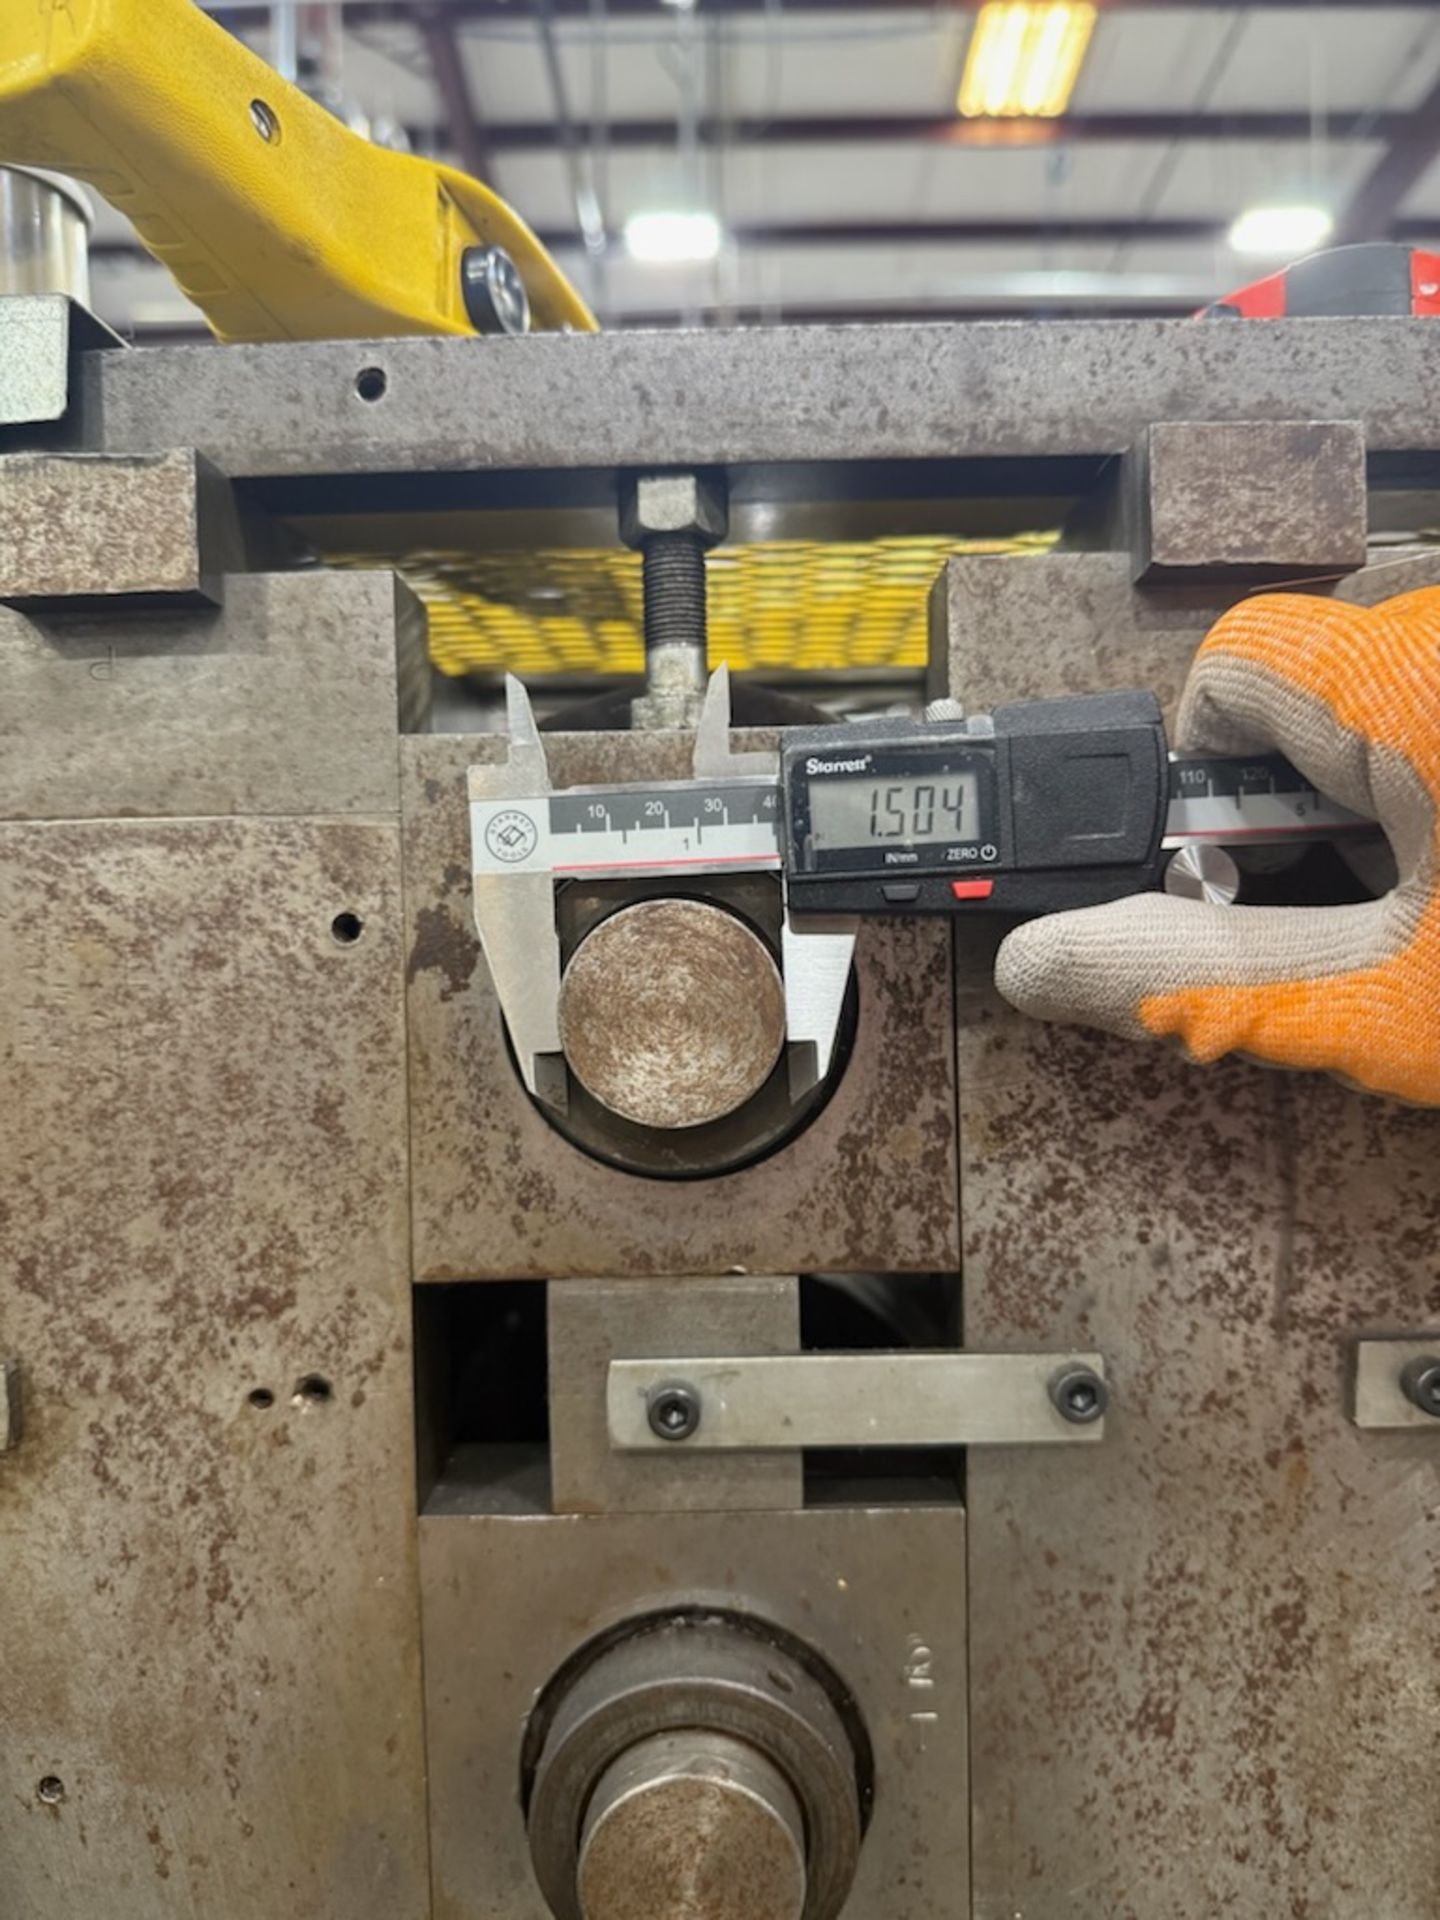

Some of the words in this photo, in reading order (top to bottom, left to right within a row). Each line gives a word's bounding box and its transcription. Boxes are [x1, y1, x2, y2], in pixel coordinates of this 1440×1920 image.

[1179, 768, 1206, 785] 110
[1241, 765, 1269, 781] 120
[587, 804, 606, 819] 10
[644, 800, 664, 816] 20
[704, 797, 723, 813] 30
[869, 784, 964, 838] 1.504
[1294, 801, 1307, 818] 5
[682, 836, 690, 851] 1
[945, 846, 978, 861] ZERO
